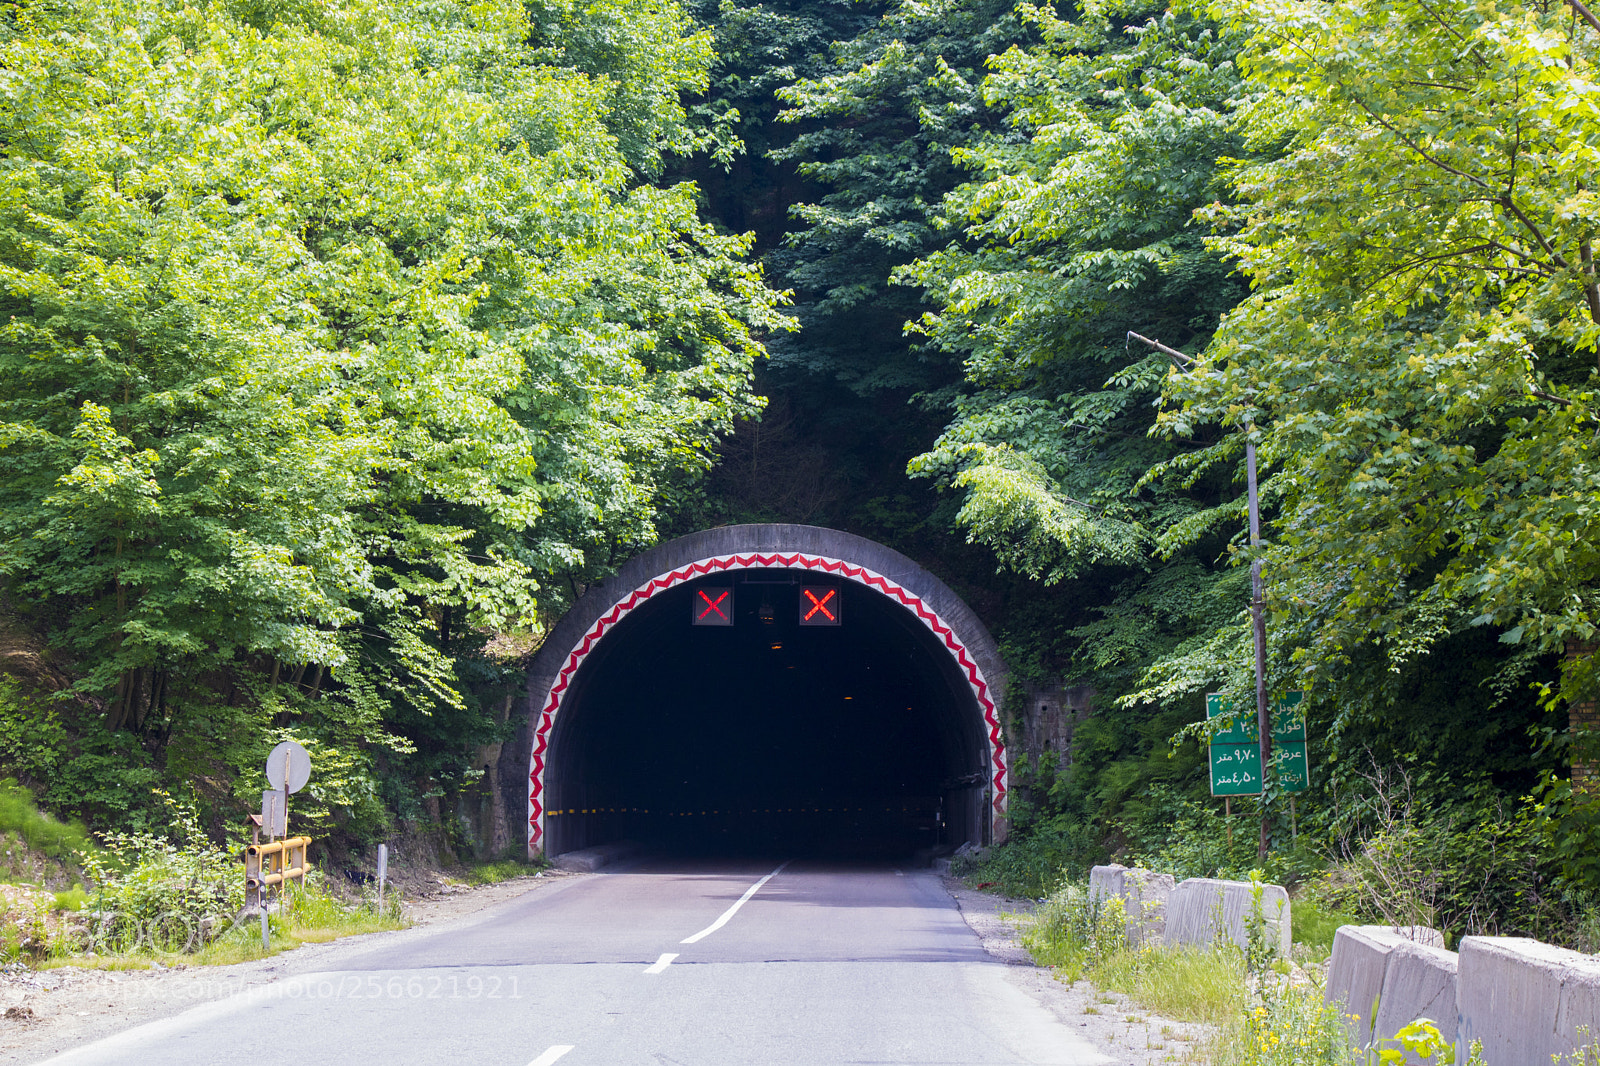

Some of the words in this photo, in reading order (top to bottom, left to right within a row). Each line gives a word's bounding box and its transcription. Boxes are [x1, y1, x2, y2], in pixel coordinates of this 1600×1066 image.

[1216, 753, 1233, 764] متر
[1275, 749, 1301, 761] عرض
[1216, 775, 1232, 786] متر
